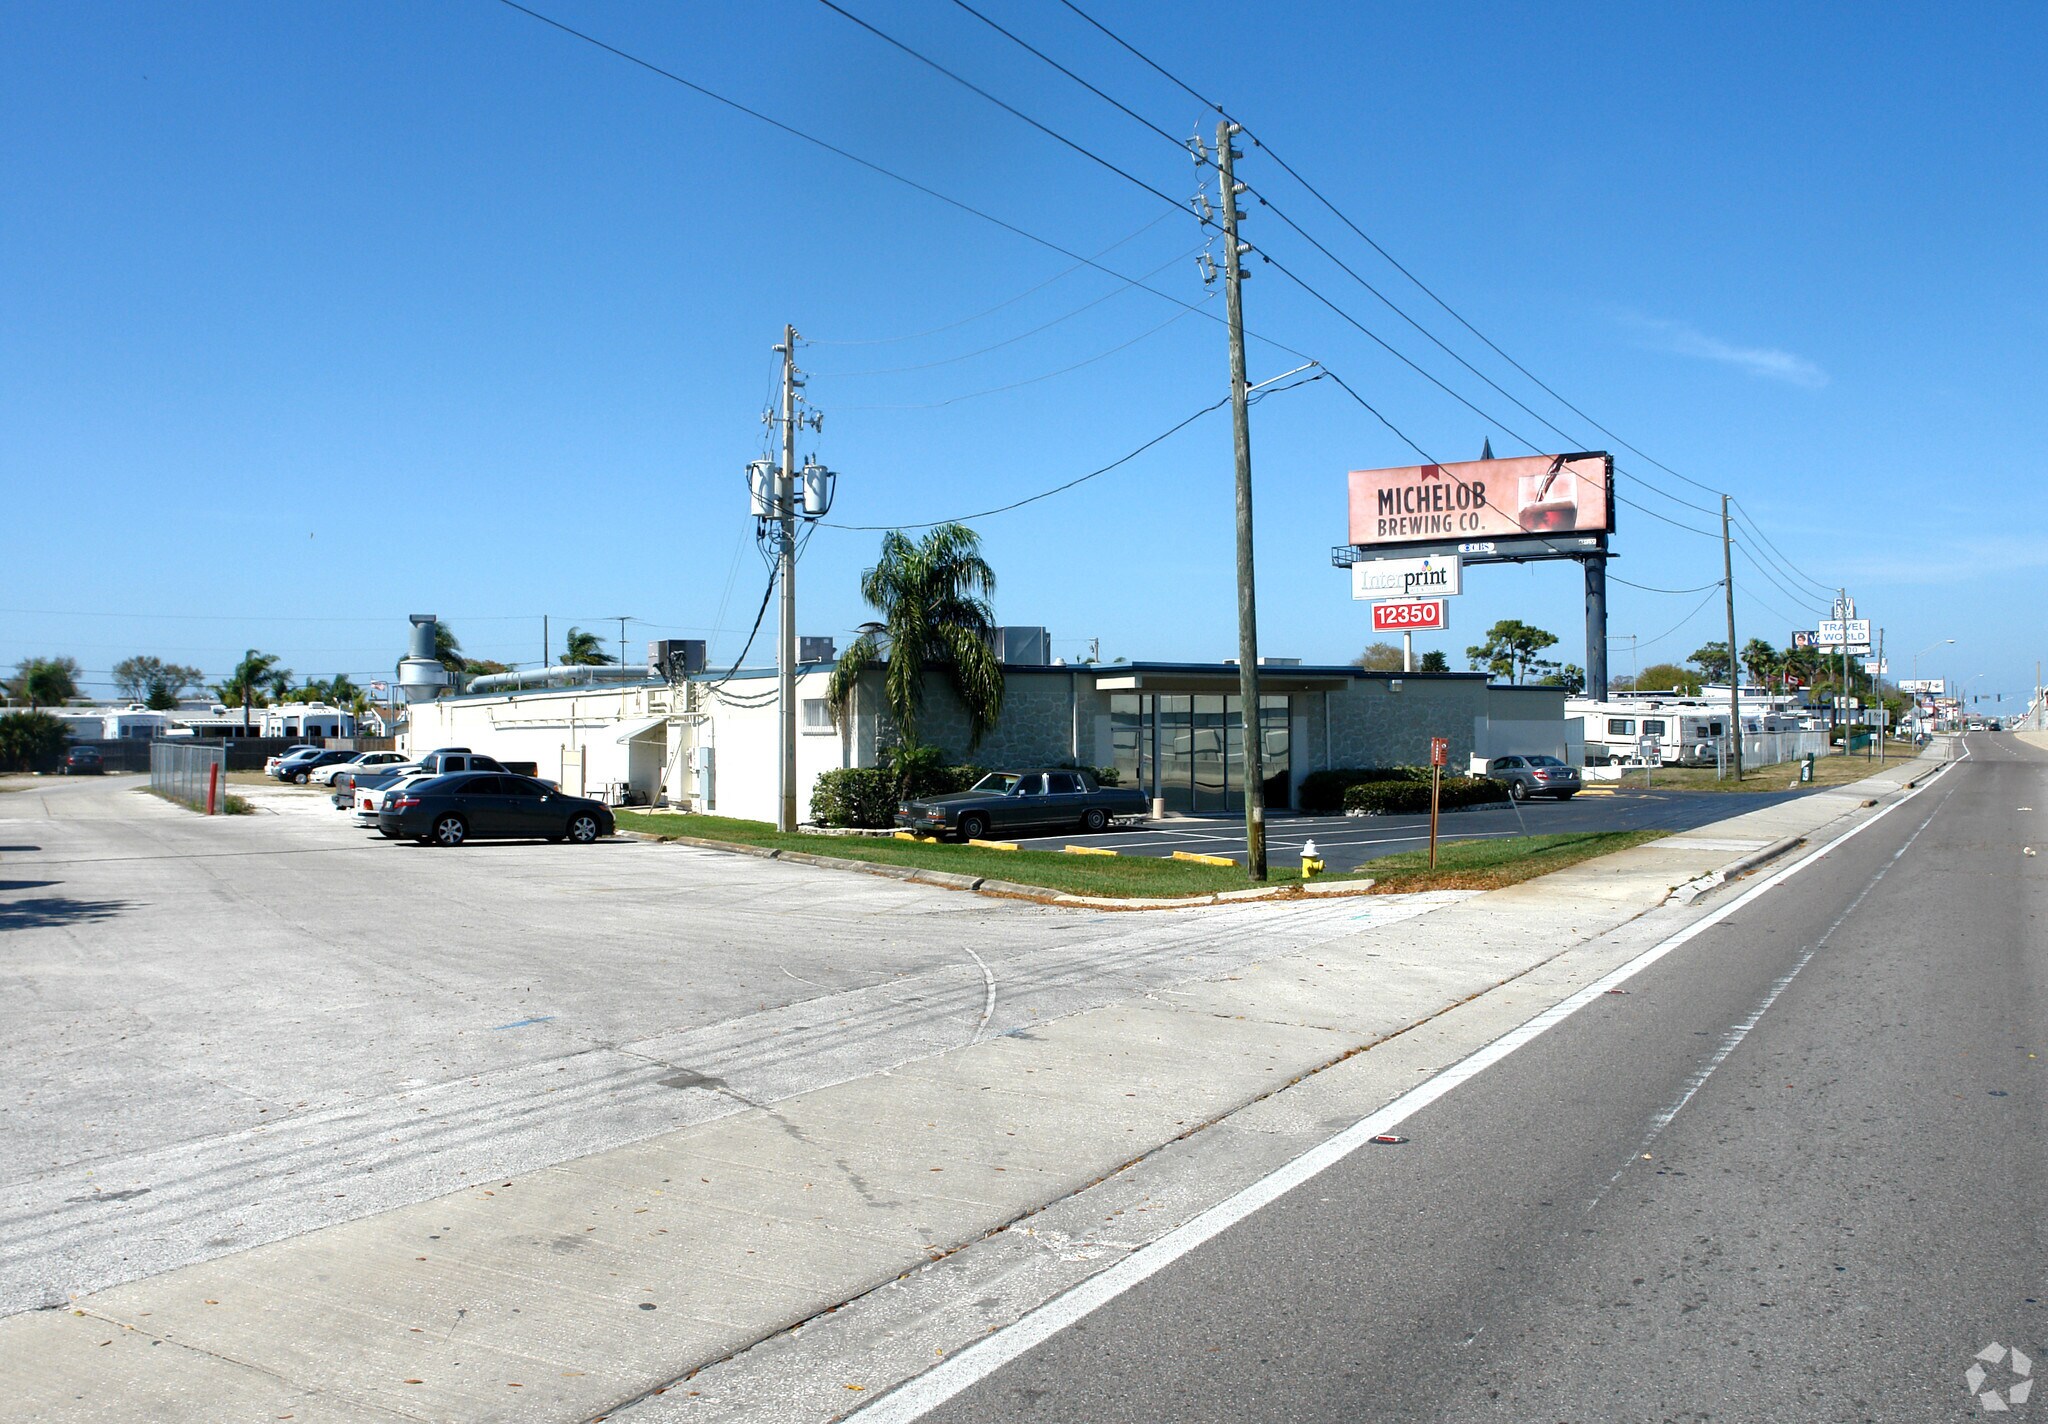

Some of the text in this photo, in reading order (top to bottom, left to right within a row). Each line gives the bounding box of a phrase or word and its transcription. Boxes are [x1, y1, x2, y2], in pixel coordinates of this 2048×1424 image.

[1378, 481, 1486, 516] MICHELOB
[1378, 512, 1486, 537] BREWING CO.
[1361, 566, 1447, 594] Interprint
[1376, 604, 1436, 624] 12350
[1823, 623, 1866, 631] TRAVEL
[1824, 633, 1866, 641] WORLD
